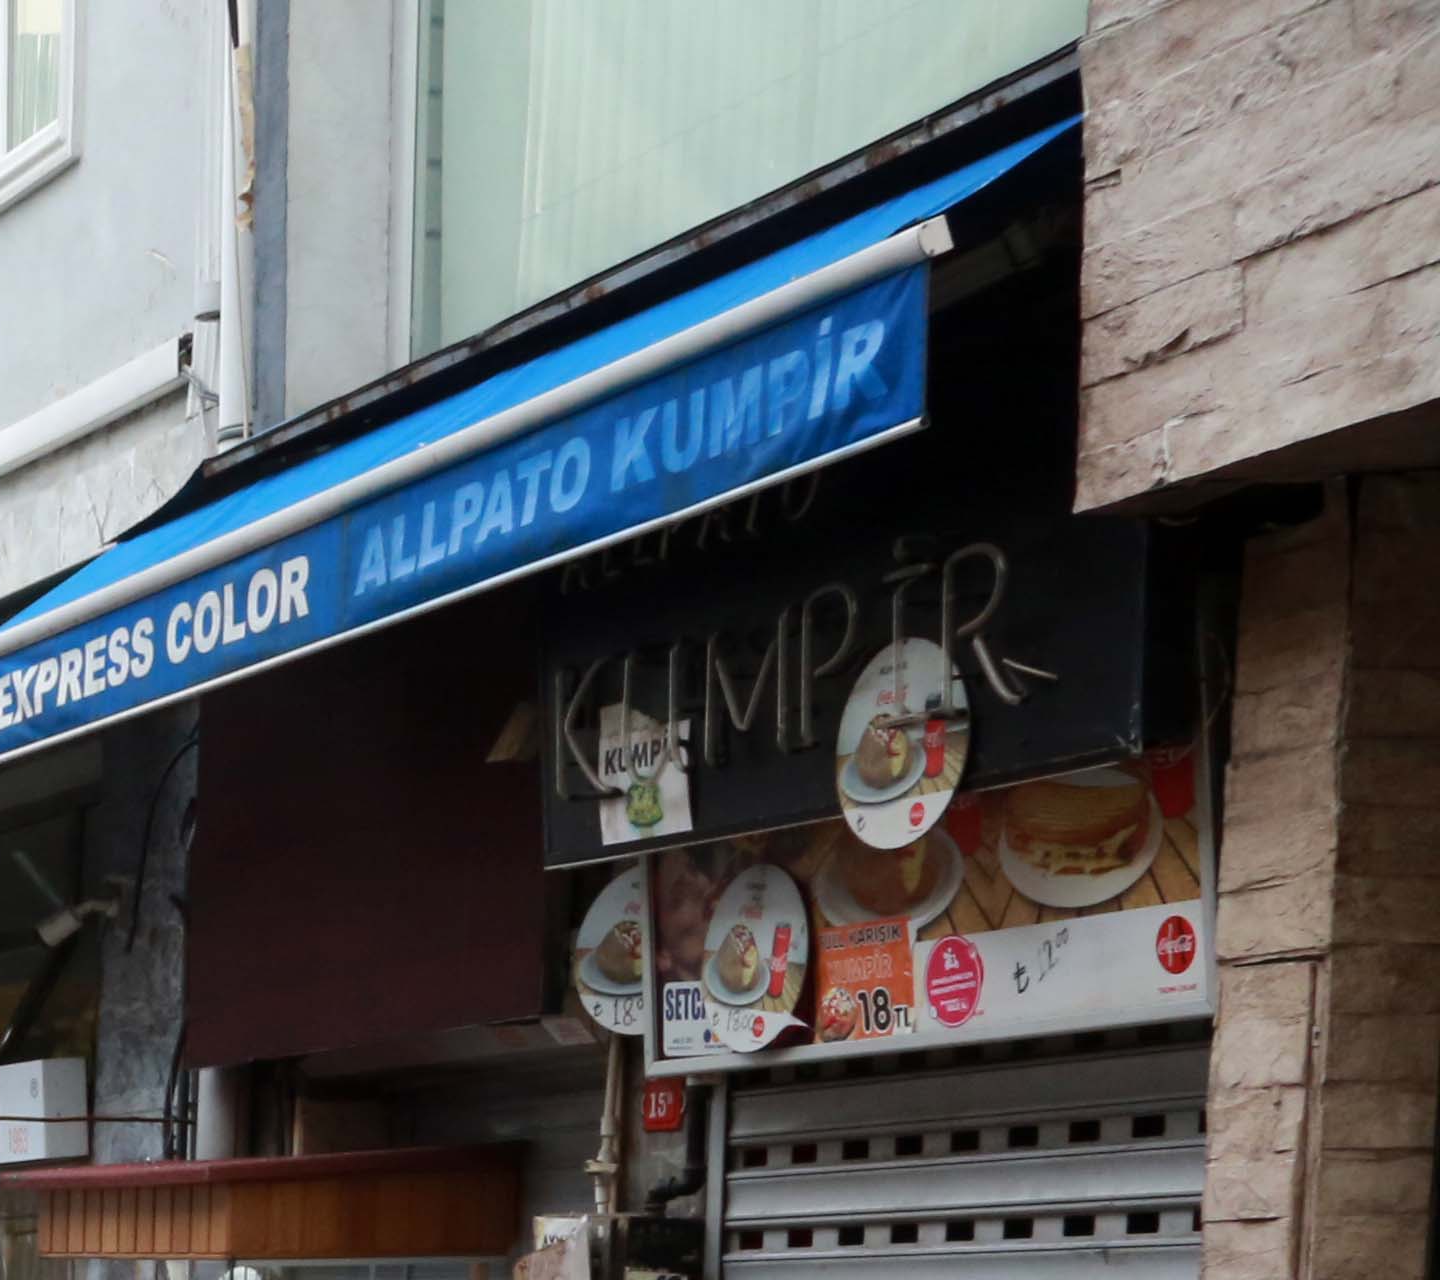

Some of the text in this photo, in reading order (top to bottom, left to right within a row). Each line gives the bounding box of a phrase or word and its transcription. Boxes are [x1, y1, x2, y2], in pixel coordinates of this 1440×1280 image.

[352, 435, 591, 600] ALLPATO
[607, 315, 888, 496] KUMPİR
[164, 553, 310, 666] COLOR
[664, 988, 706, 1022] SETC
[857, 986, 892, 1032] 18
[893, 1005, 912, 1029] TL
